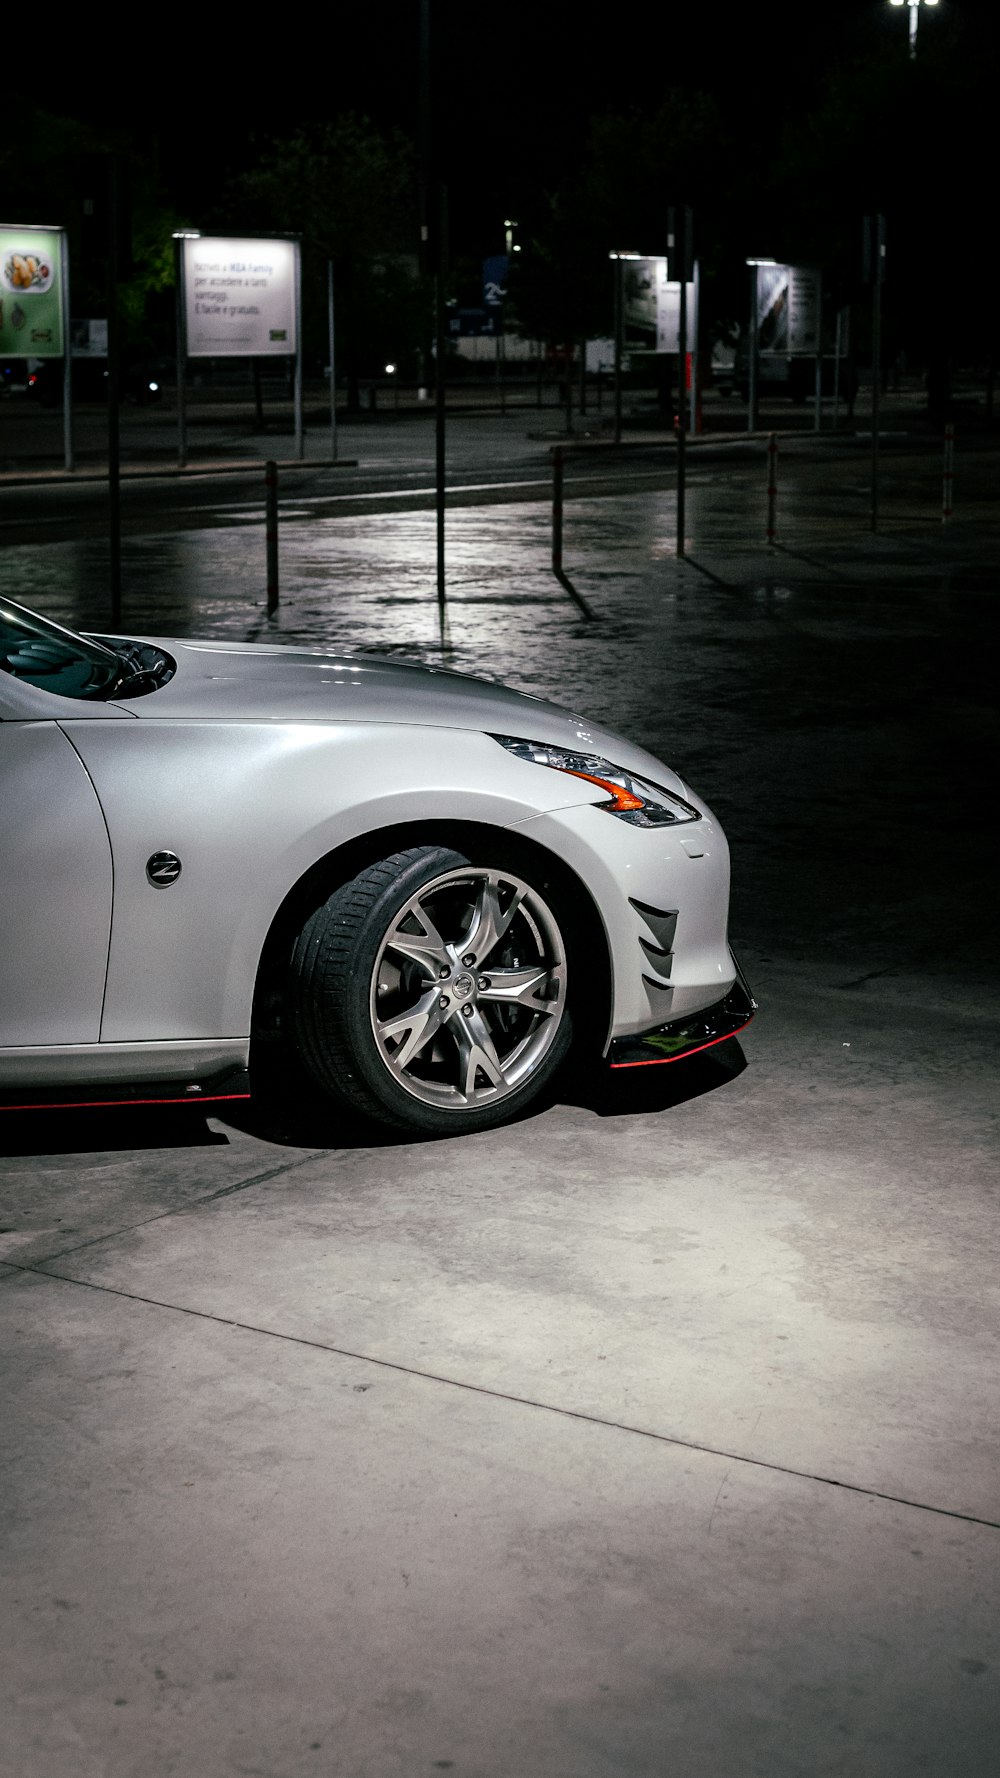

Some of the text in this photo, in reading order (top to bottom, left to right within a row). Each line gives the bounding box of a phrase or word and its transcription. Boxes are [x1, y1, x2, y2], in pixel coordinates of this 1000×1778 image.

[230, 263, 246, 272] IKEA
[248, 263, 273, 275] Family
[194, 277, 207, 287] per
[210, 277, 242, 287] accedere
